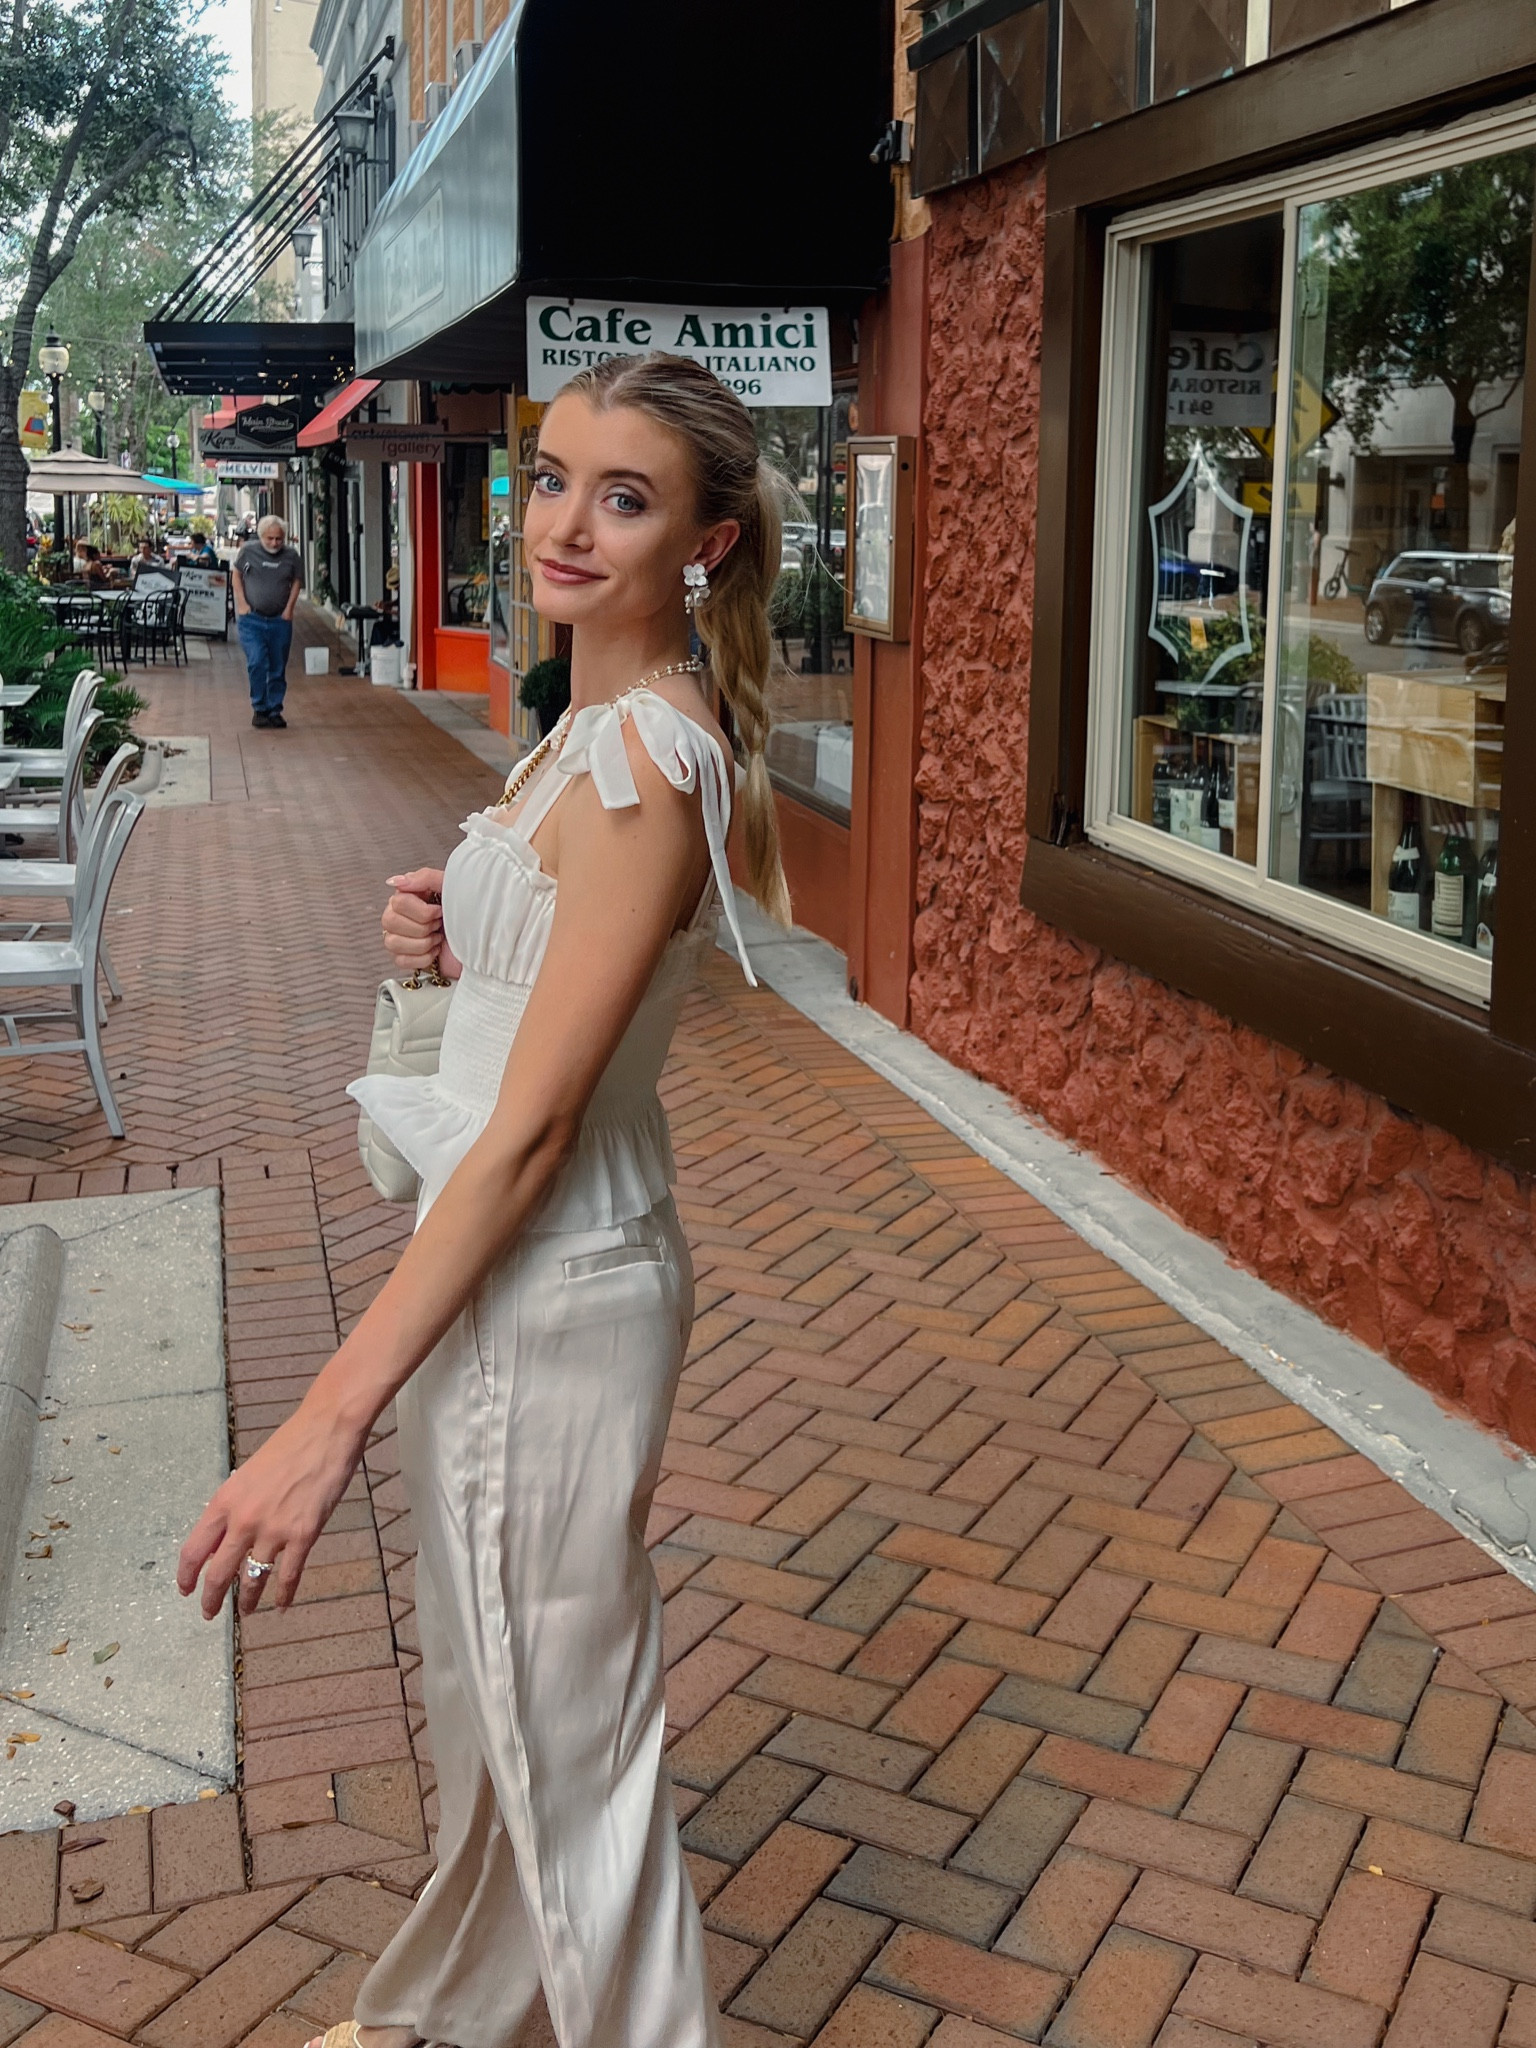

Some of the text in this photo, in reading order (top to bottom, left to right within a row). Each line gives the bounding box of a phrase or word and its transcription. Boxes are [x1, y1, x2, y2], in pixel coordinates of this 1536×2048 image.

[538, 305, 818, 348] Cafe Amici
[706, 355, 816, 373] ITALIANO
[387, 441, 440, 458] gallery
